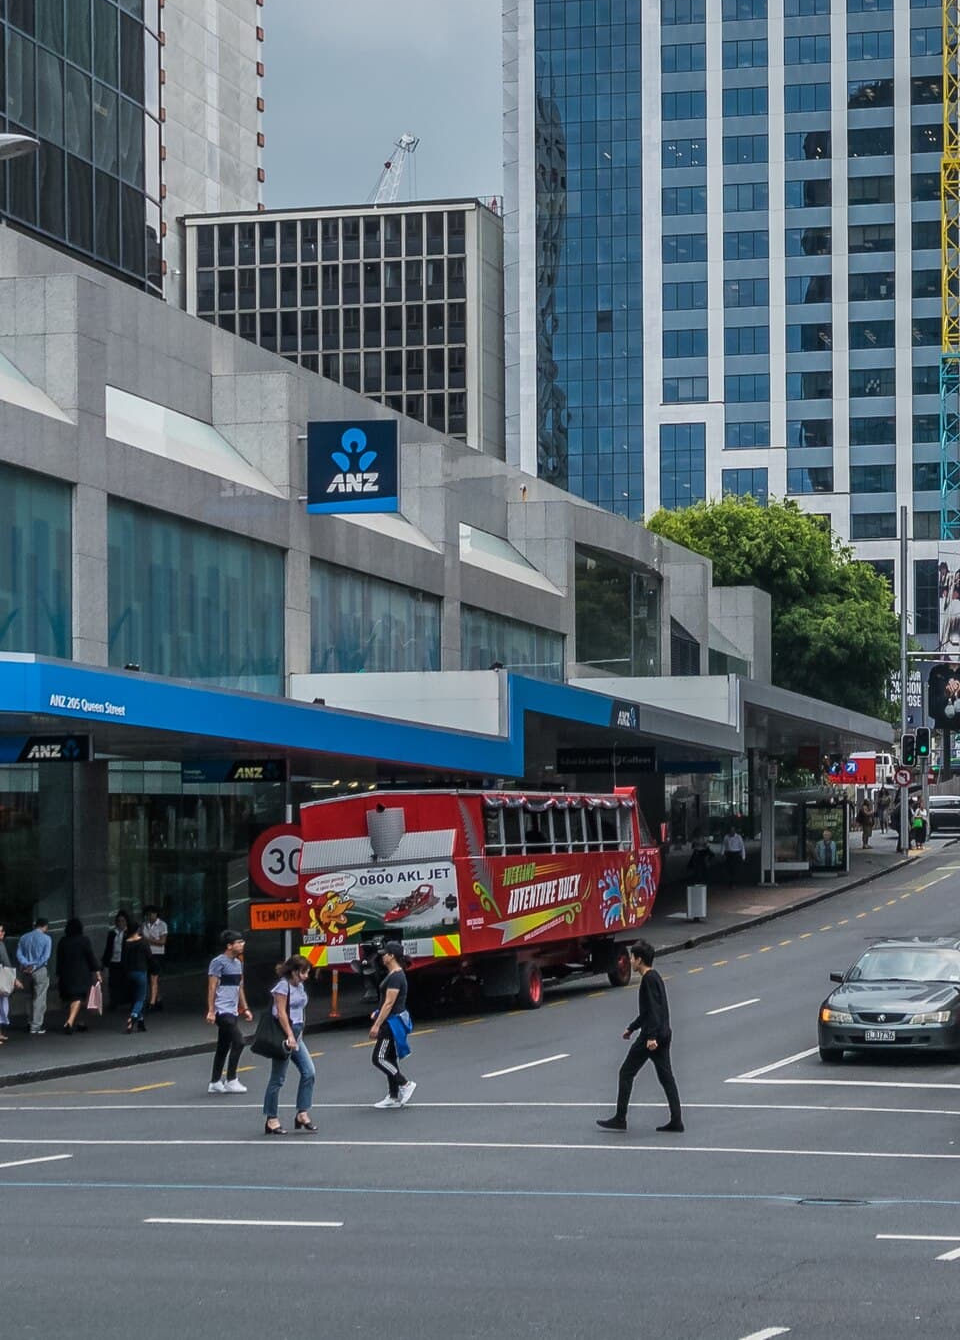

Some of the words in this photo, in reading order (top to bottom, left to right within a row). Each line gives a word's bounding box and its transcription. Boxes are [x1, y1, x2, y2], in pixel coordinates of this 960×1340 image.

[326, 472, 379, 493] ANZ
[49, 693, 66, 708] ANZ
[66, 696, 81, 710] 205
[81, 698, 104, 713] Queen
[104, 701, 126, 717] Street
[27, 744, 62, 759] ANZ
[233, 767, 264, 779] ANZ
[359, 873, 393, 886] 0800
[397, 869, 424, 882] AKL
[428, 867, 450, 879] JET
[507, 878, 557, 915] ADVENTURE
[557, 874, 582, 902] DUCK
